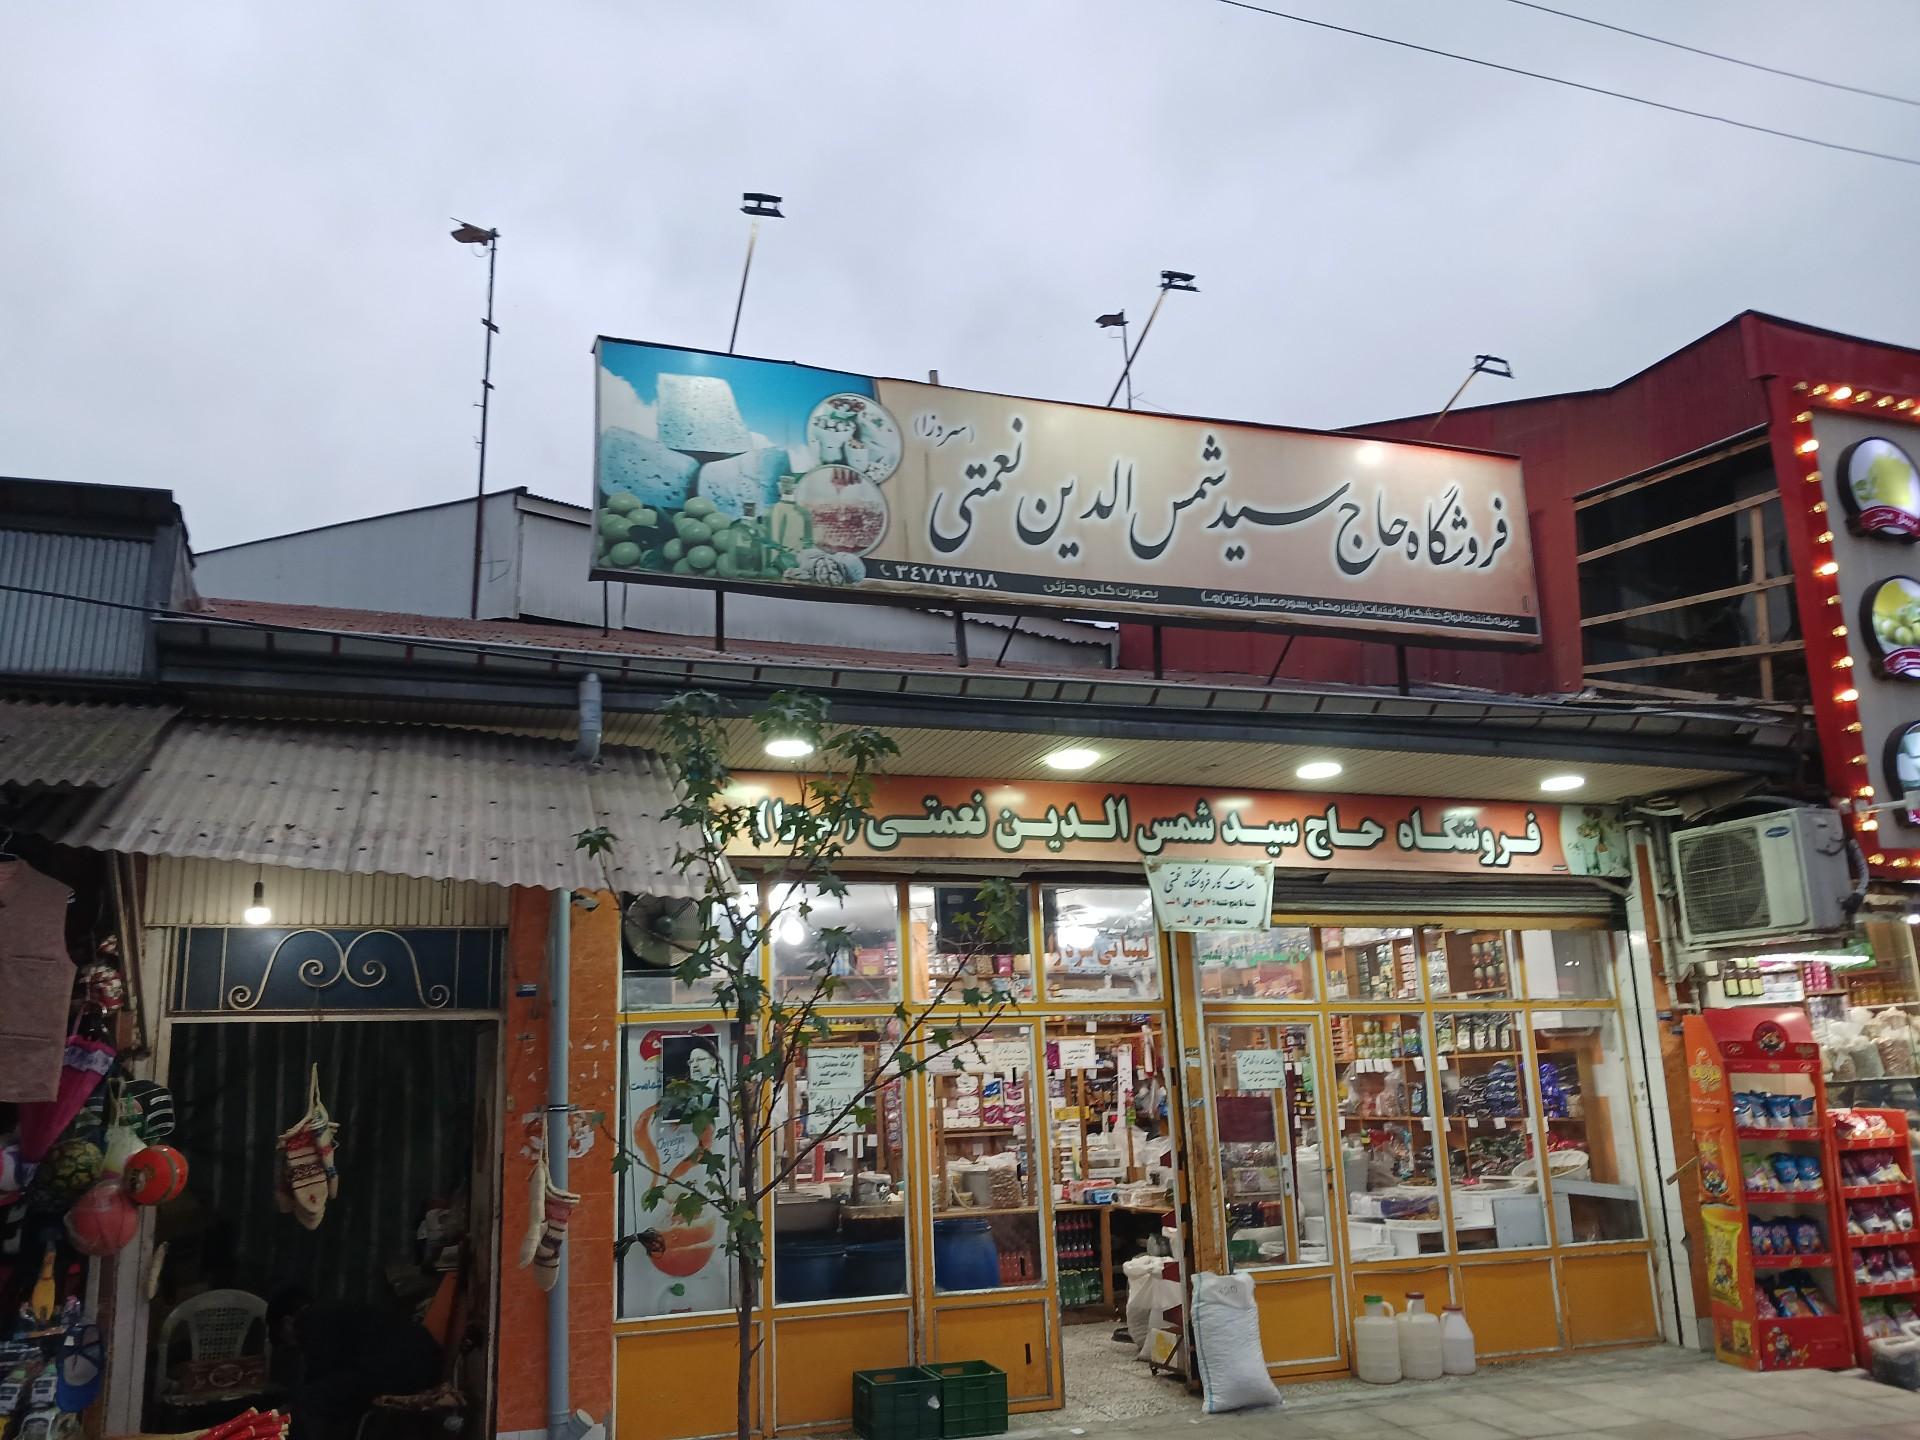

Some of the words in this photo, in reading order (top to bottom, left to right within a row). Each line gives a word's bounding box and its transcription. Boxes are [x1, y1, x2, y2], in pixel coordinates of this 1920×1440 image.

[928, 417, 1024, 554] نعمتی
[1130, 434, 1227, 560] شمس
[1016, 459, 1133, 560] الدین
[1207, 481, 1351, 561] سید
[1336, 489, 1408, 576] حاج
[1406, 484, 1509, 569] فروشگاه
[1078, 585, 1087, 596] و
[1087, 583, 1116, 597] کلی
[1117, 586, 1160, 602] بصورت
[1249, 594, 1279, 607] عسل
[1308, 599, 1340, 612] محلی
[1403, 606, 1442, 621] خشکبار
[1441, 609, 1464, 624] انواع
[1463, 613, 1494, 625] کننده
[1493, 615, 1521, 629] عرضه
[864, 789, 988, 850] نعمتی
[994, 796, 1130, 852] الدین
[1136, 797, 1216, 855] شمس
[1220, 806, 1300, 857] سید
[1304, 803, 1384, 859] حاج
[1398, 805, 1543, 867] فروشگاه
[1164, 866, 1182, 893] نعمتی
[1184, 867, 1211, 893] فروشگاه
[1211, 867, 1231, 889] کار
[1224, 877, 1255, 890] ساعت
